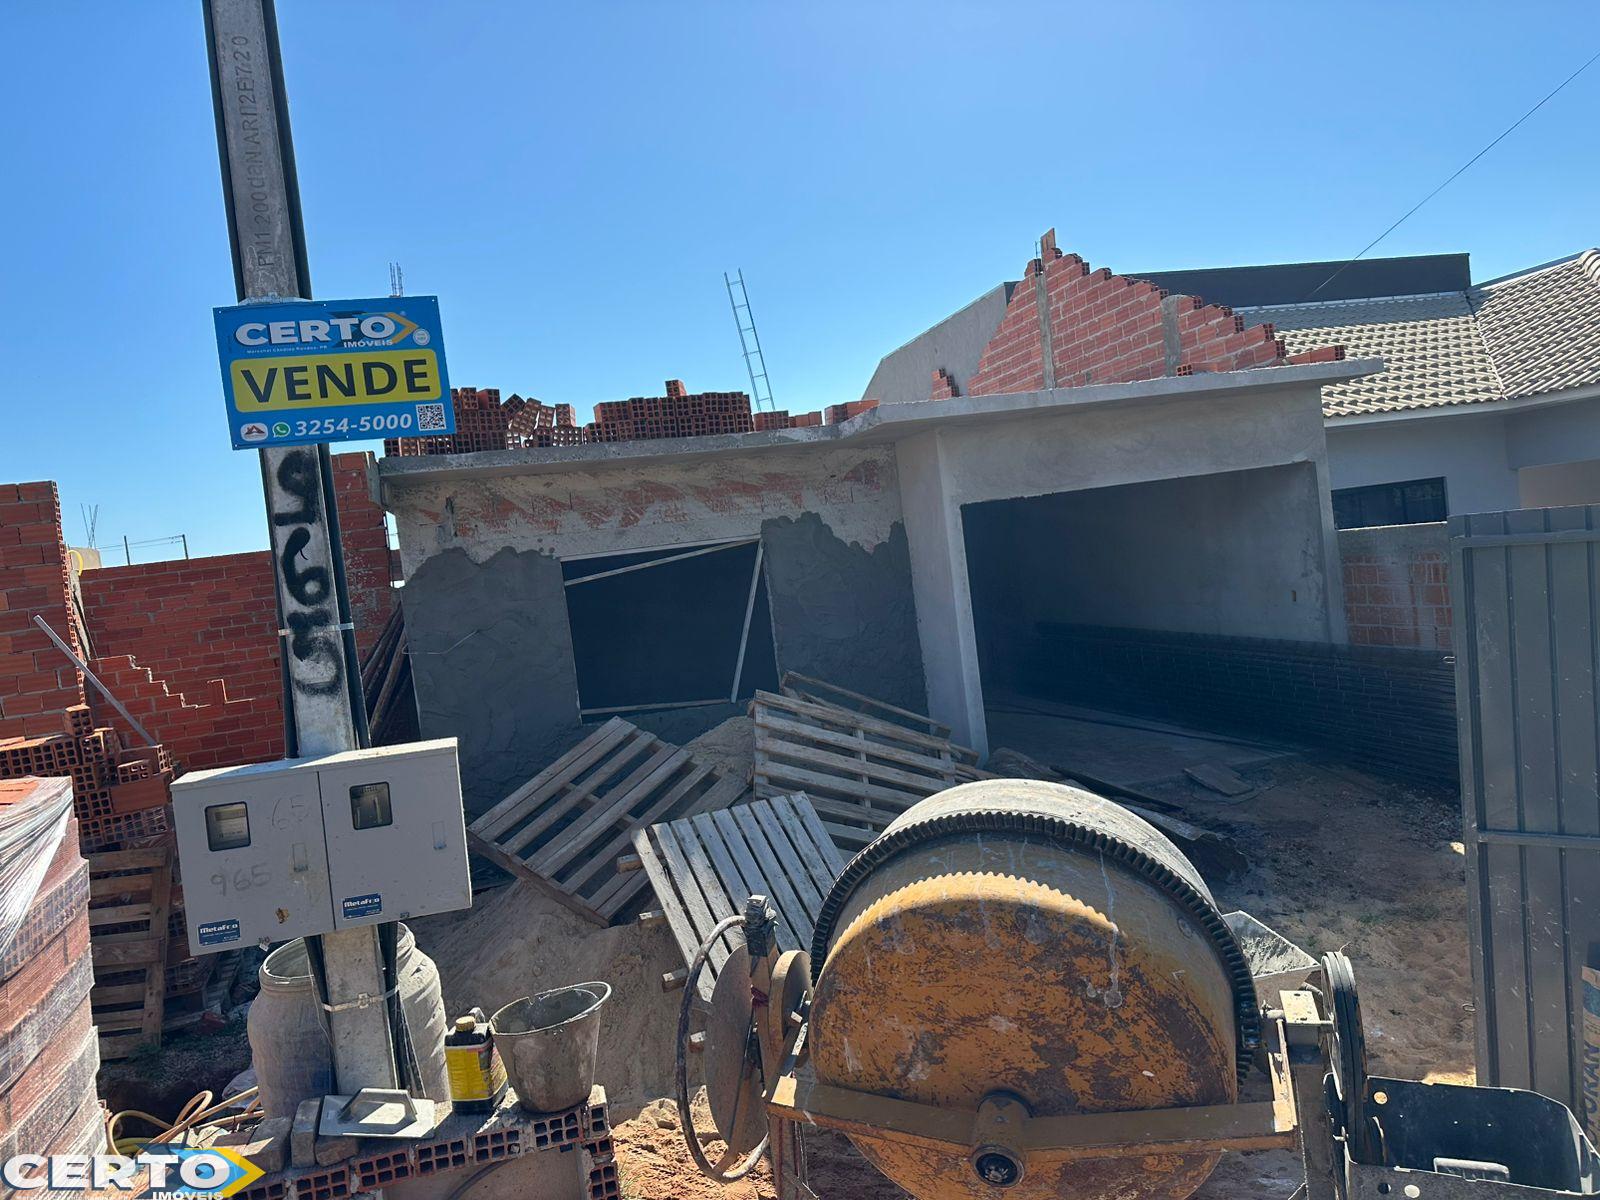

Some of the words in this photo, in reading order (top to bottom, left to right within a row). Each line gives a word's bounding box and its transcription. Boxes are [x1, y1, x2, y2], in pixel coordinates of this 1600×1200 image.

[235, 315, 397, 347] CERTO
[343, 338, 395, 349] IMÓVEIS
[240, 358, 431, 403] VENDE
[294, 413, 413, 436] 3254-5000
[210, 863, 271, 896] 965
